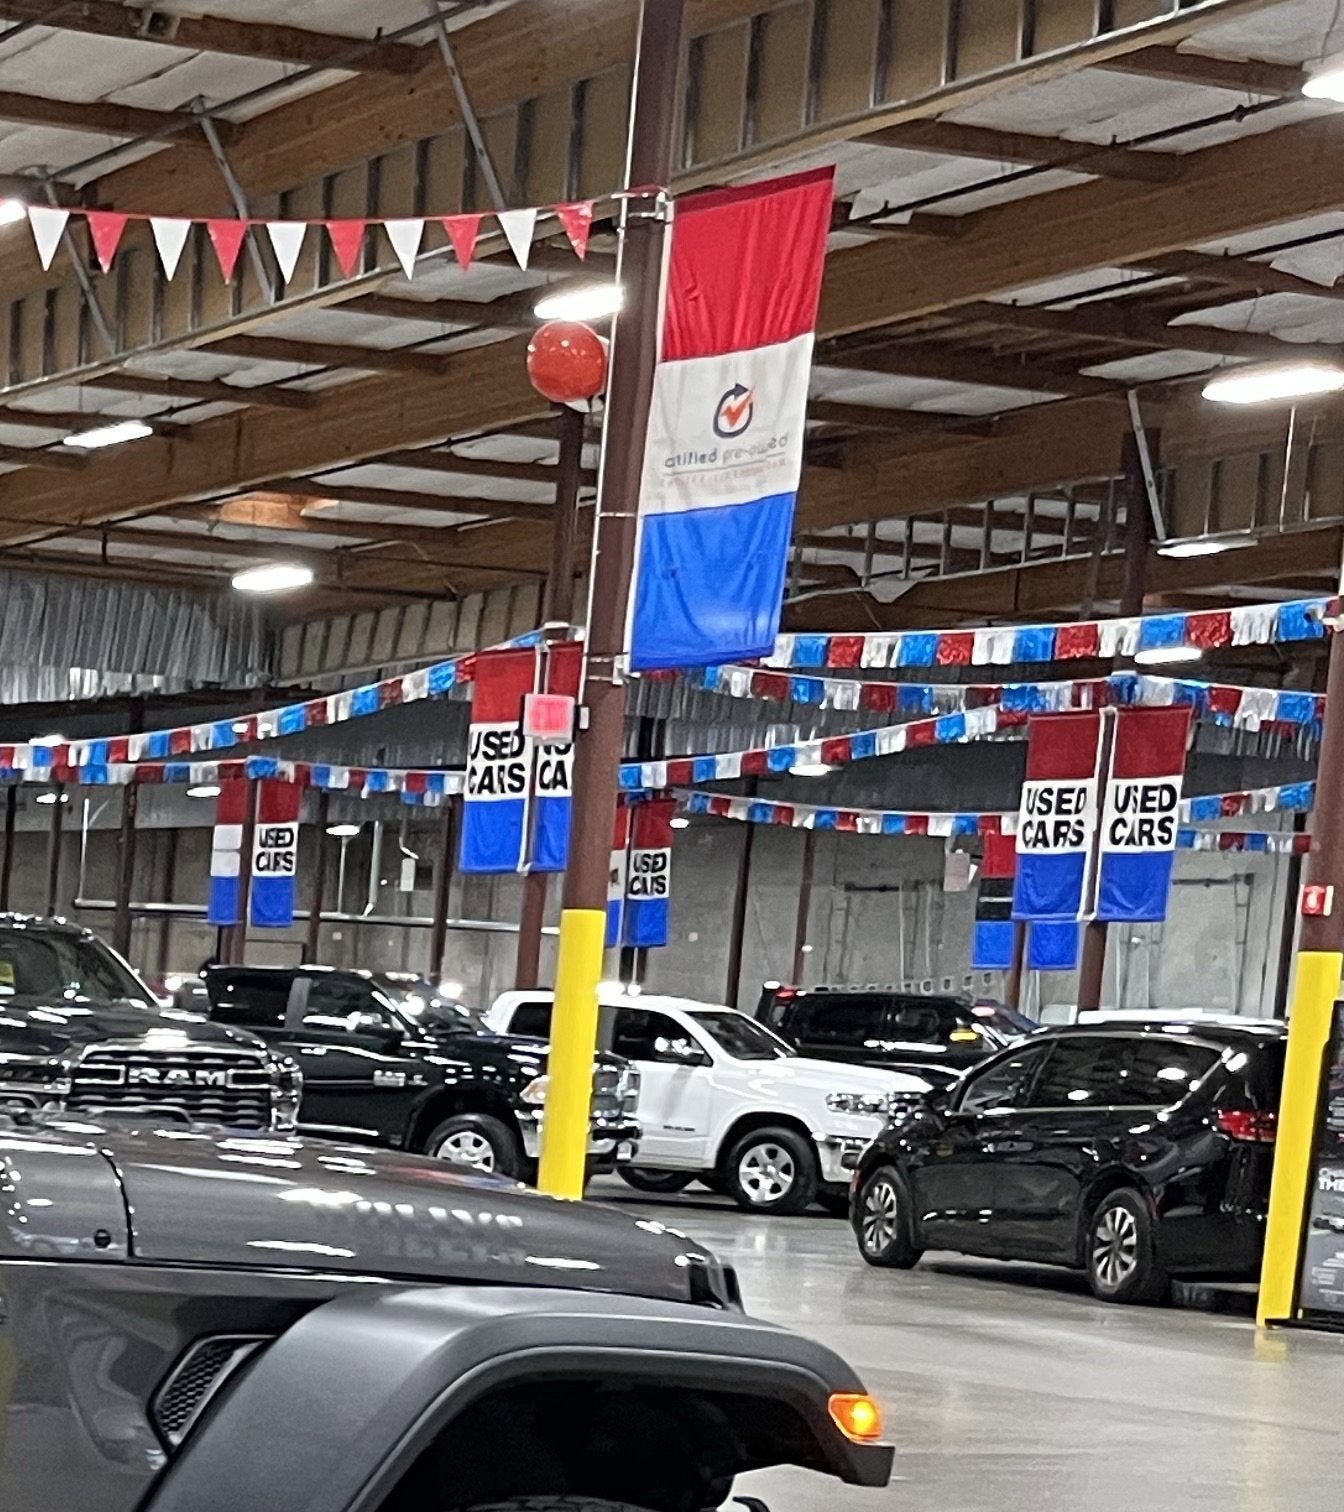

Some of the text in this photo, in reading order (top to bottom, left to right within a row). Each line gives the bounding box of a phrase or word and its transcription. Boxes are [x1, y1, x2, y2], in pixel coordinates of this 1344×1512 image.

[468, 730, 526, 761] USED
[467, 762, 526, 794] CARS
[539, 759, 569, 790] CA
[1026, 786, 1087, 816] USED
[1114, 783, 1178, 814] USED
[1022, 819, 1085, 848] CARS
[1109, 816, 1175, 846] CARS
[128, 1066, 226, 1086] RAM
